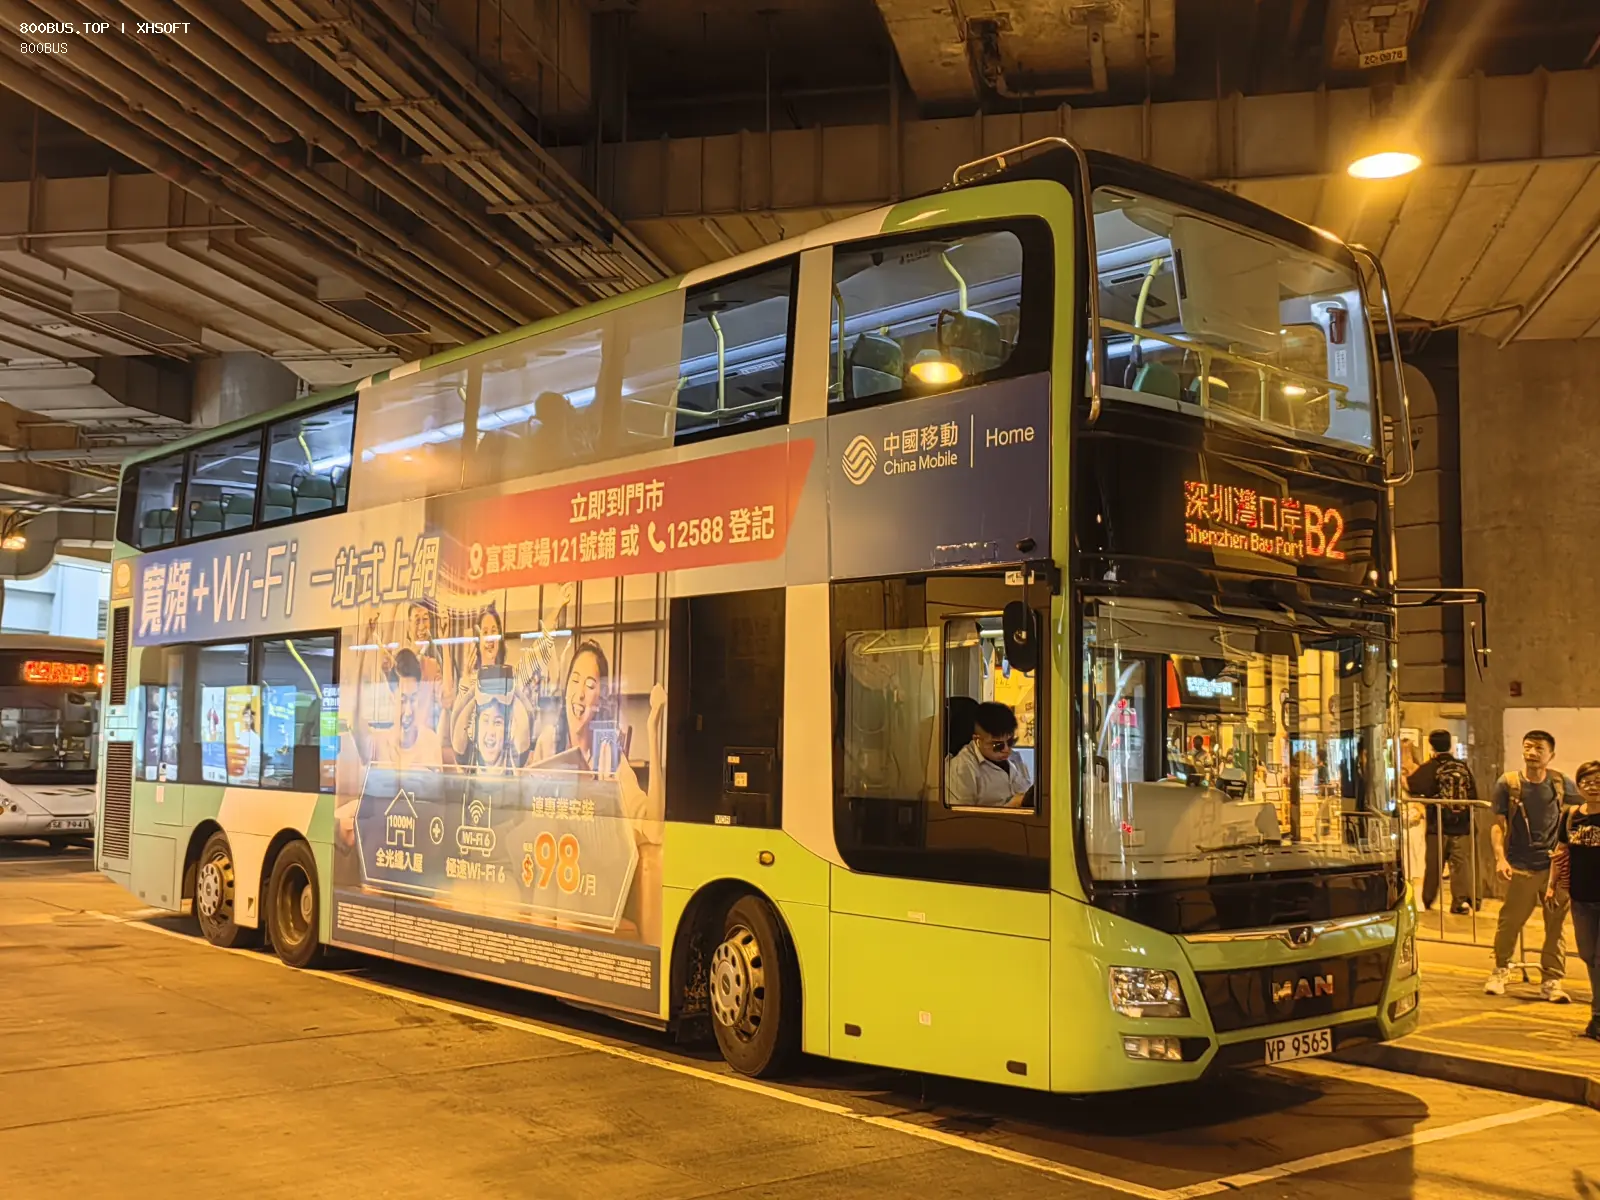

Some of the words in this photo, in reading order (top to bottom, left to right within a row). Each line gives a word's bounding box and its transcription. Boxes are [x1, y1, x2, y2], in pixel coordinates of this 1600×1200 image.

[883, 420, 959, 457] 中國移動
[986, 426, 1035, 448] Home
[883, 458, 917, 476] China
[919, 450, 958, 470] Mobile
[569, 478, 665, 524] 立即到門市
[1184, 480, 1302, 534] 深圳灣口岸
[620, 523, 640, 557] 或
[667, 515, 724, 549] 12588
[728, 505, 775, 544] 登記
[1185, 522, 1248, 551] Shenzhen
[1250, 531, 1273, 554] Bay
[1276, 536, 1305, 558] Port
[1304, 503, 1346, 560] B2
[310, 536, 441, 607] 一站式上網
[389, 814, 413, 830] 1000M
[462, 831, 483, 846] Wi-Fi
[484, 833, 491, 847] 6
[497, 866, 506, 884] 6
[1272, 974, 1334, 1004] MAN
[1266, 1039, 1286, 1062] VP
[1291, 1031, 1330, 1056] 9565
